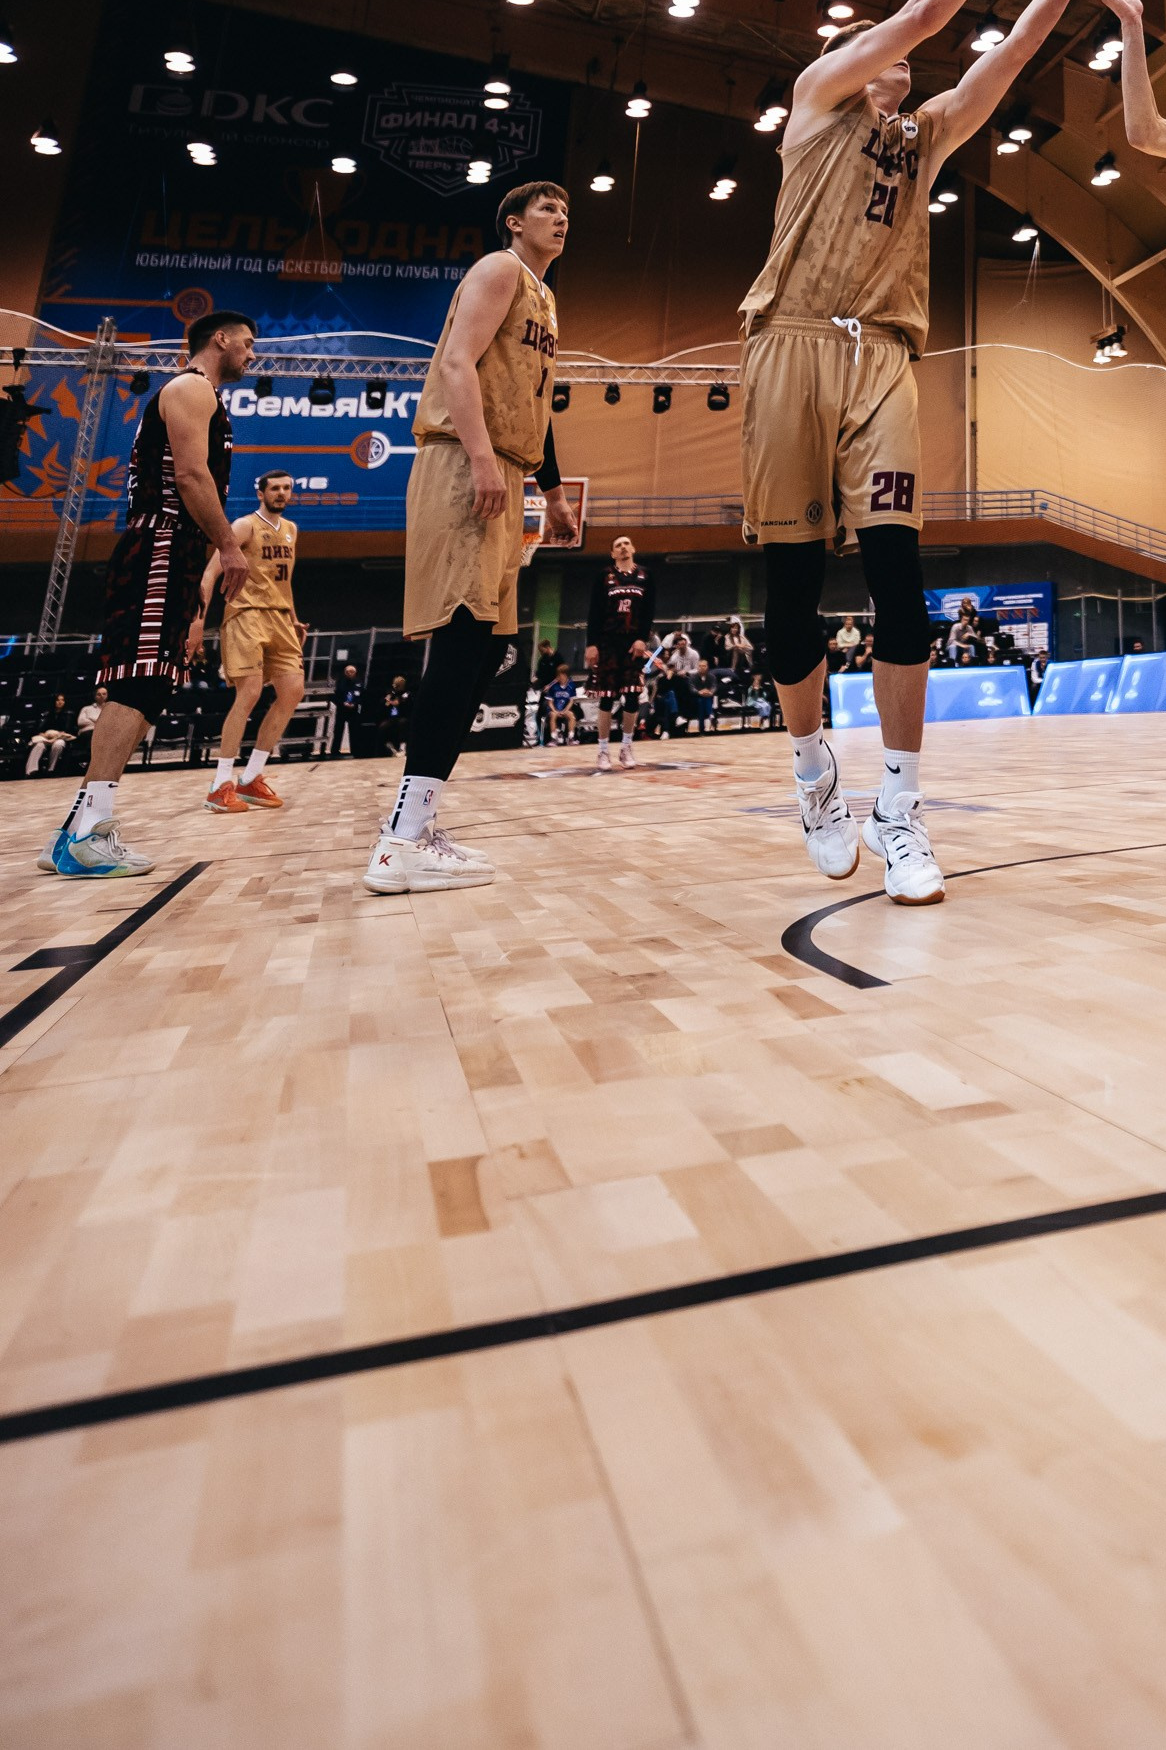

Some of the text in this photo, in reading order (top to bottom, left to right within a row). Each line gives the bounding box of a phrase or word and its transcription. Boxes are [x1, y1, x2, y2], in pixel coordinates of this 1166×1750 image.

[380, 111, 478, 131] ФИНАЛ
[139, 207, 485, 260] ЦЕЛЬ ОДНА
[135, 251, 232, 271] ЮБИЛЕЙНЫЙ
[235, 254, 263, 273] ГОД
[267, 257, 392, 278] БАСКЕТБОЛЬНОГО
[395, 261, 439, 280] КЛУБА
[521, 318, 555, 359] ЦИВ
[535, 366, 549, 398] 1
[870, 470, 916, 514] 28
[274, 563, 289, 582] 31
